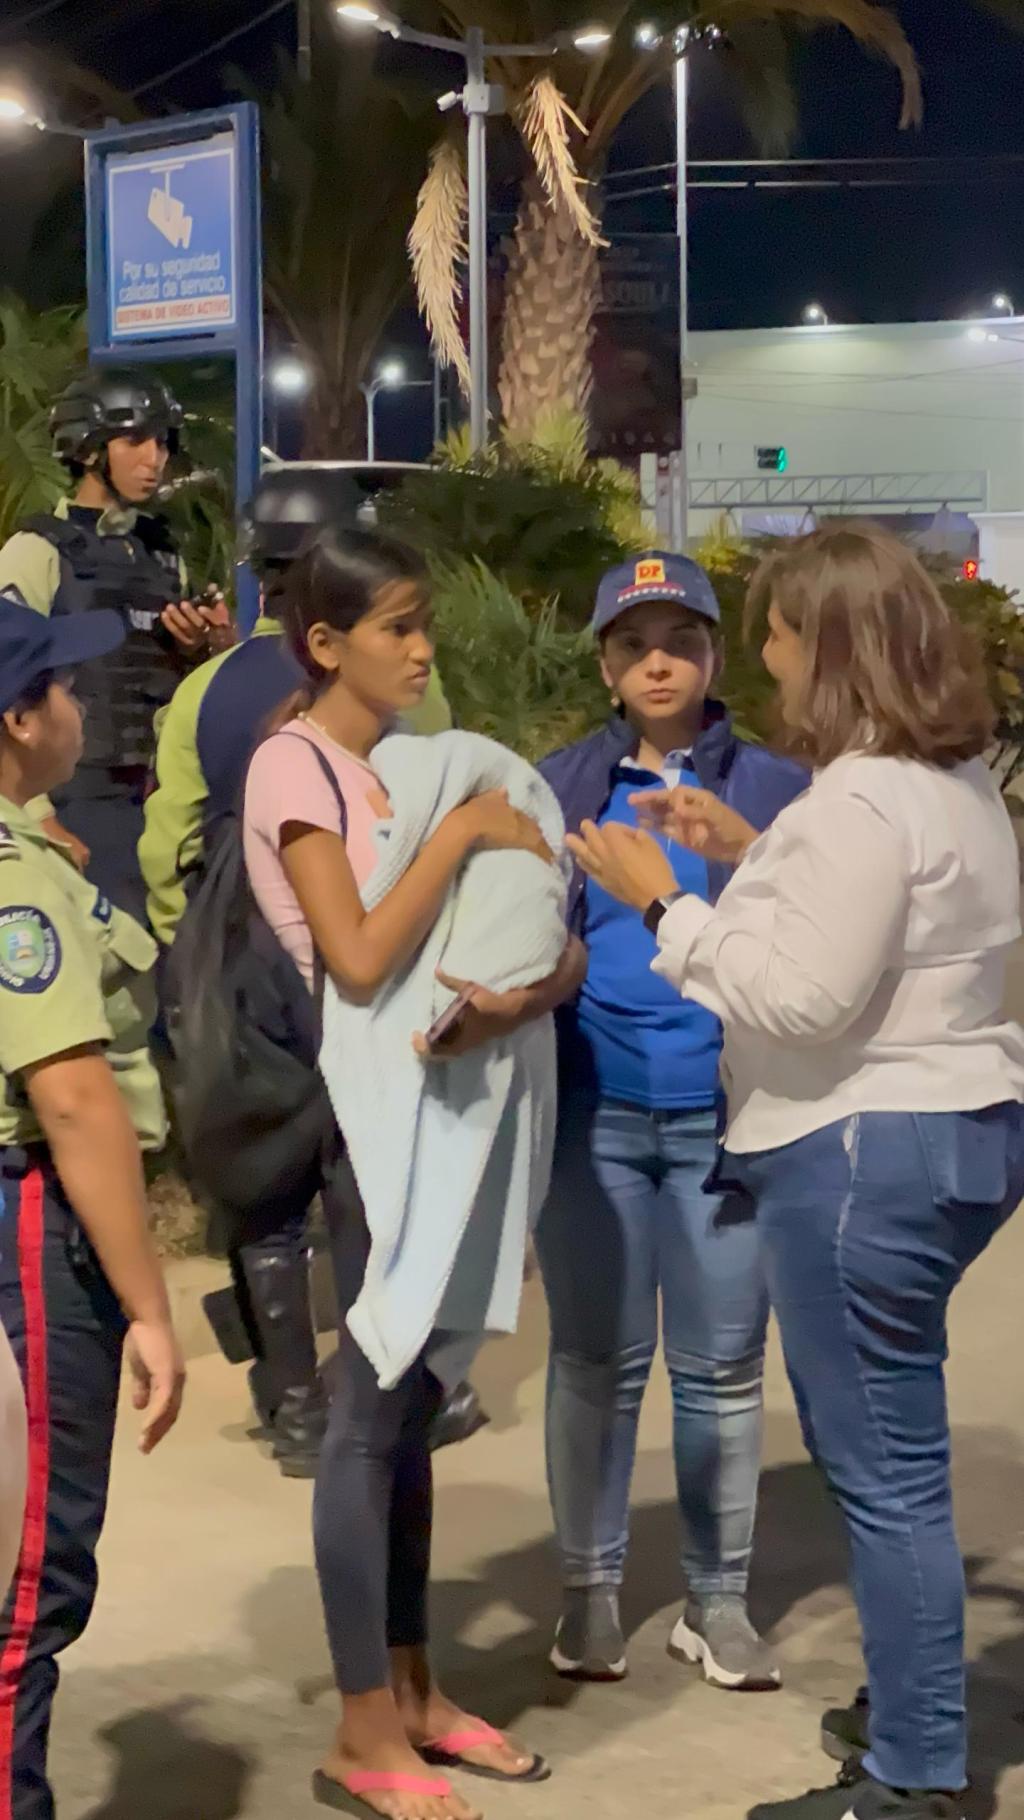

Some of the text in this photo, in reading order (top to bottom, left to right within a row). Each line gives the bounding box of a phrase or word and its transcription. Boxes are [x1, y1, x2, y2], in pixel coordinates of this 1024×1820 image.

[123, 254, 220, 281] Por su seguridad
[119, 276, 225, 303] calidad de servicio
[155, 306, 166, 319] DE
[169, 303, 193, 317] VIDEO
[197, 300, 228, 313] ACTIVO
[639, 564, 661, 579] DP
